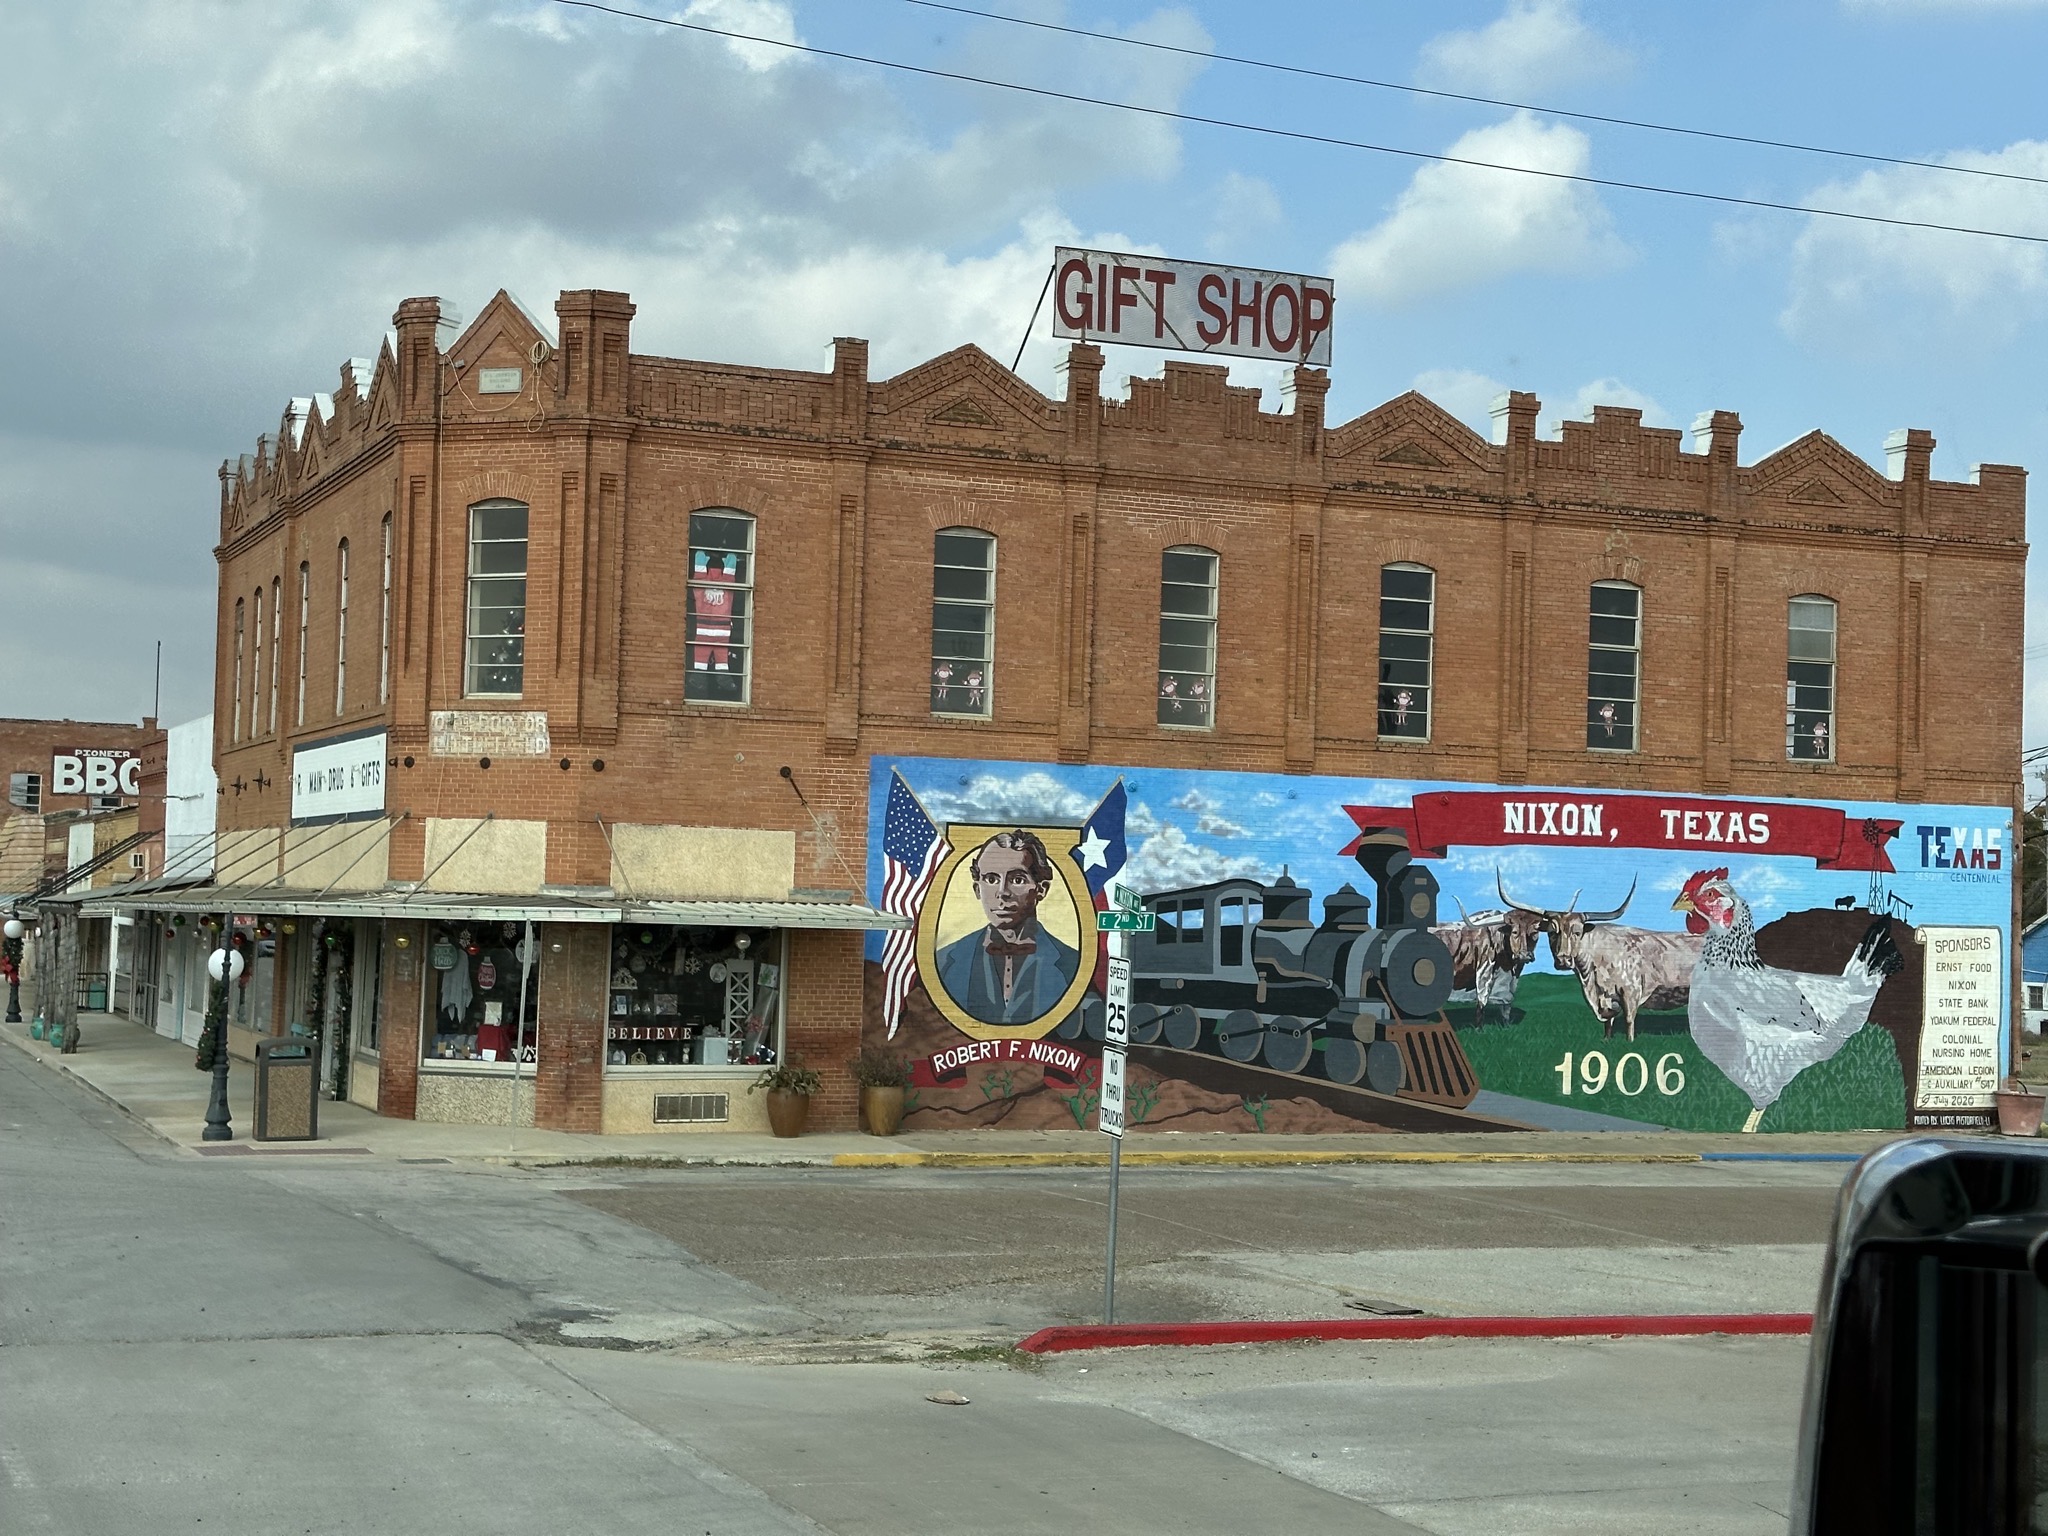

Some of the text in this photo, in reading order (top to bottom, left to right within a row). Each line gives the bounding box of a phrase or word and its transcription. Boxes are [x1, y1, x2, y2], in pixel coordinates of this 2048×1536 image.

[1057, 259, 1331, 354] GIFT SHOP
[75, 749, 130, 758] PIONEER
[328, 767, 344, 791] DRUG
[361, 760, 380, 787] GIFTS
[1503, 802, 1770, 844] NIXON, TEXAS
[1917, 826, 2001, 870] TEXAS
[1950, 873, 2001, 883] CENTENNIAL
[1102, 914, 1149, 929] E 2ND ST
[1935, 937, 1991, 953] SPONSORS
[1110, 966, 1127, 980] SPEED
[1936, 963, 1991, 973] ERNST FOOD
[1111, 985, 1125, 996] LIMIT
[1948, 981, 1976, 990] NIXON
[1938, 999, 1988, 1008] STATE BANK
[1108, 1002, 1126, 1035] 25
[1930, 1016, 1996, 1026] YOAKUM FEDERAL
[608, 1027, 691, 1040] BELIEVE
[1942, 1034, 1983, 1044] COLONIAL
[933, 1040, 1080, 1072] ROBERT F. NIXON
[1932, 1049, 1991, 1058] NURSING HOME
[1110, 1058, 1118, 1075] NO
[1554, 1050, 1686, 1096] 1906
[1924, 1066, 1995, 1075] AMERICAN LEGION
[1935, 1080, 1973, 1089] AUXILIARY
[1106, 1083, 1120, 1102] THRU
[1934, 1096, 1974, 1106] July 2020
[1101, 1107, 1122, 1128] TRUCKS
